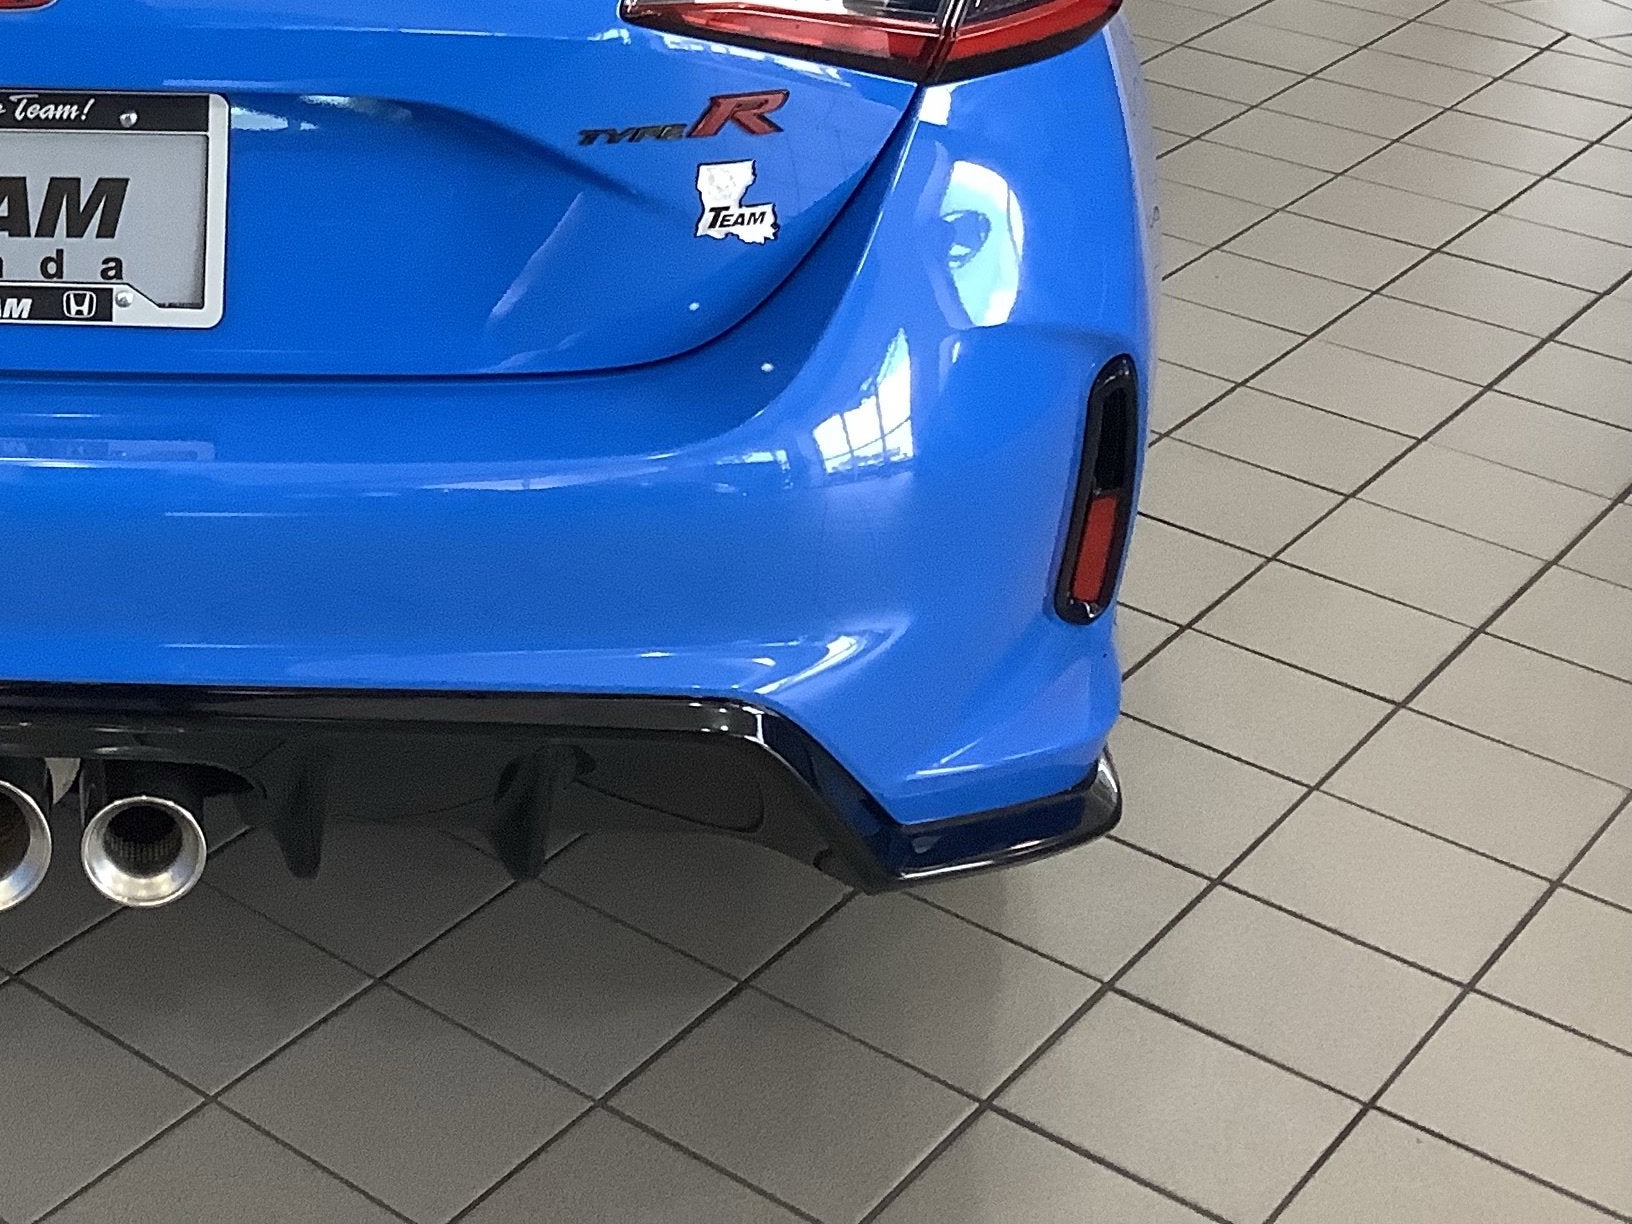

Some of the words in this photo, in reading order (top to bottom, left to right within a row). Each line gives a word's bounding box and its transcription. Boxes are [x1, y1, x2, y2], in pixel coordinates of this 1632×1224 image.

[13, 93, 95, 122] Team!
[578, 123, 688, 146] TYPE
[686, 89, 790, 138] R
[707, 206, 766, 230] TEAM
